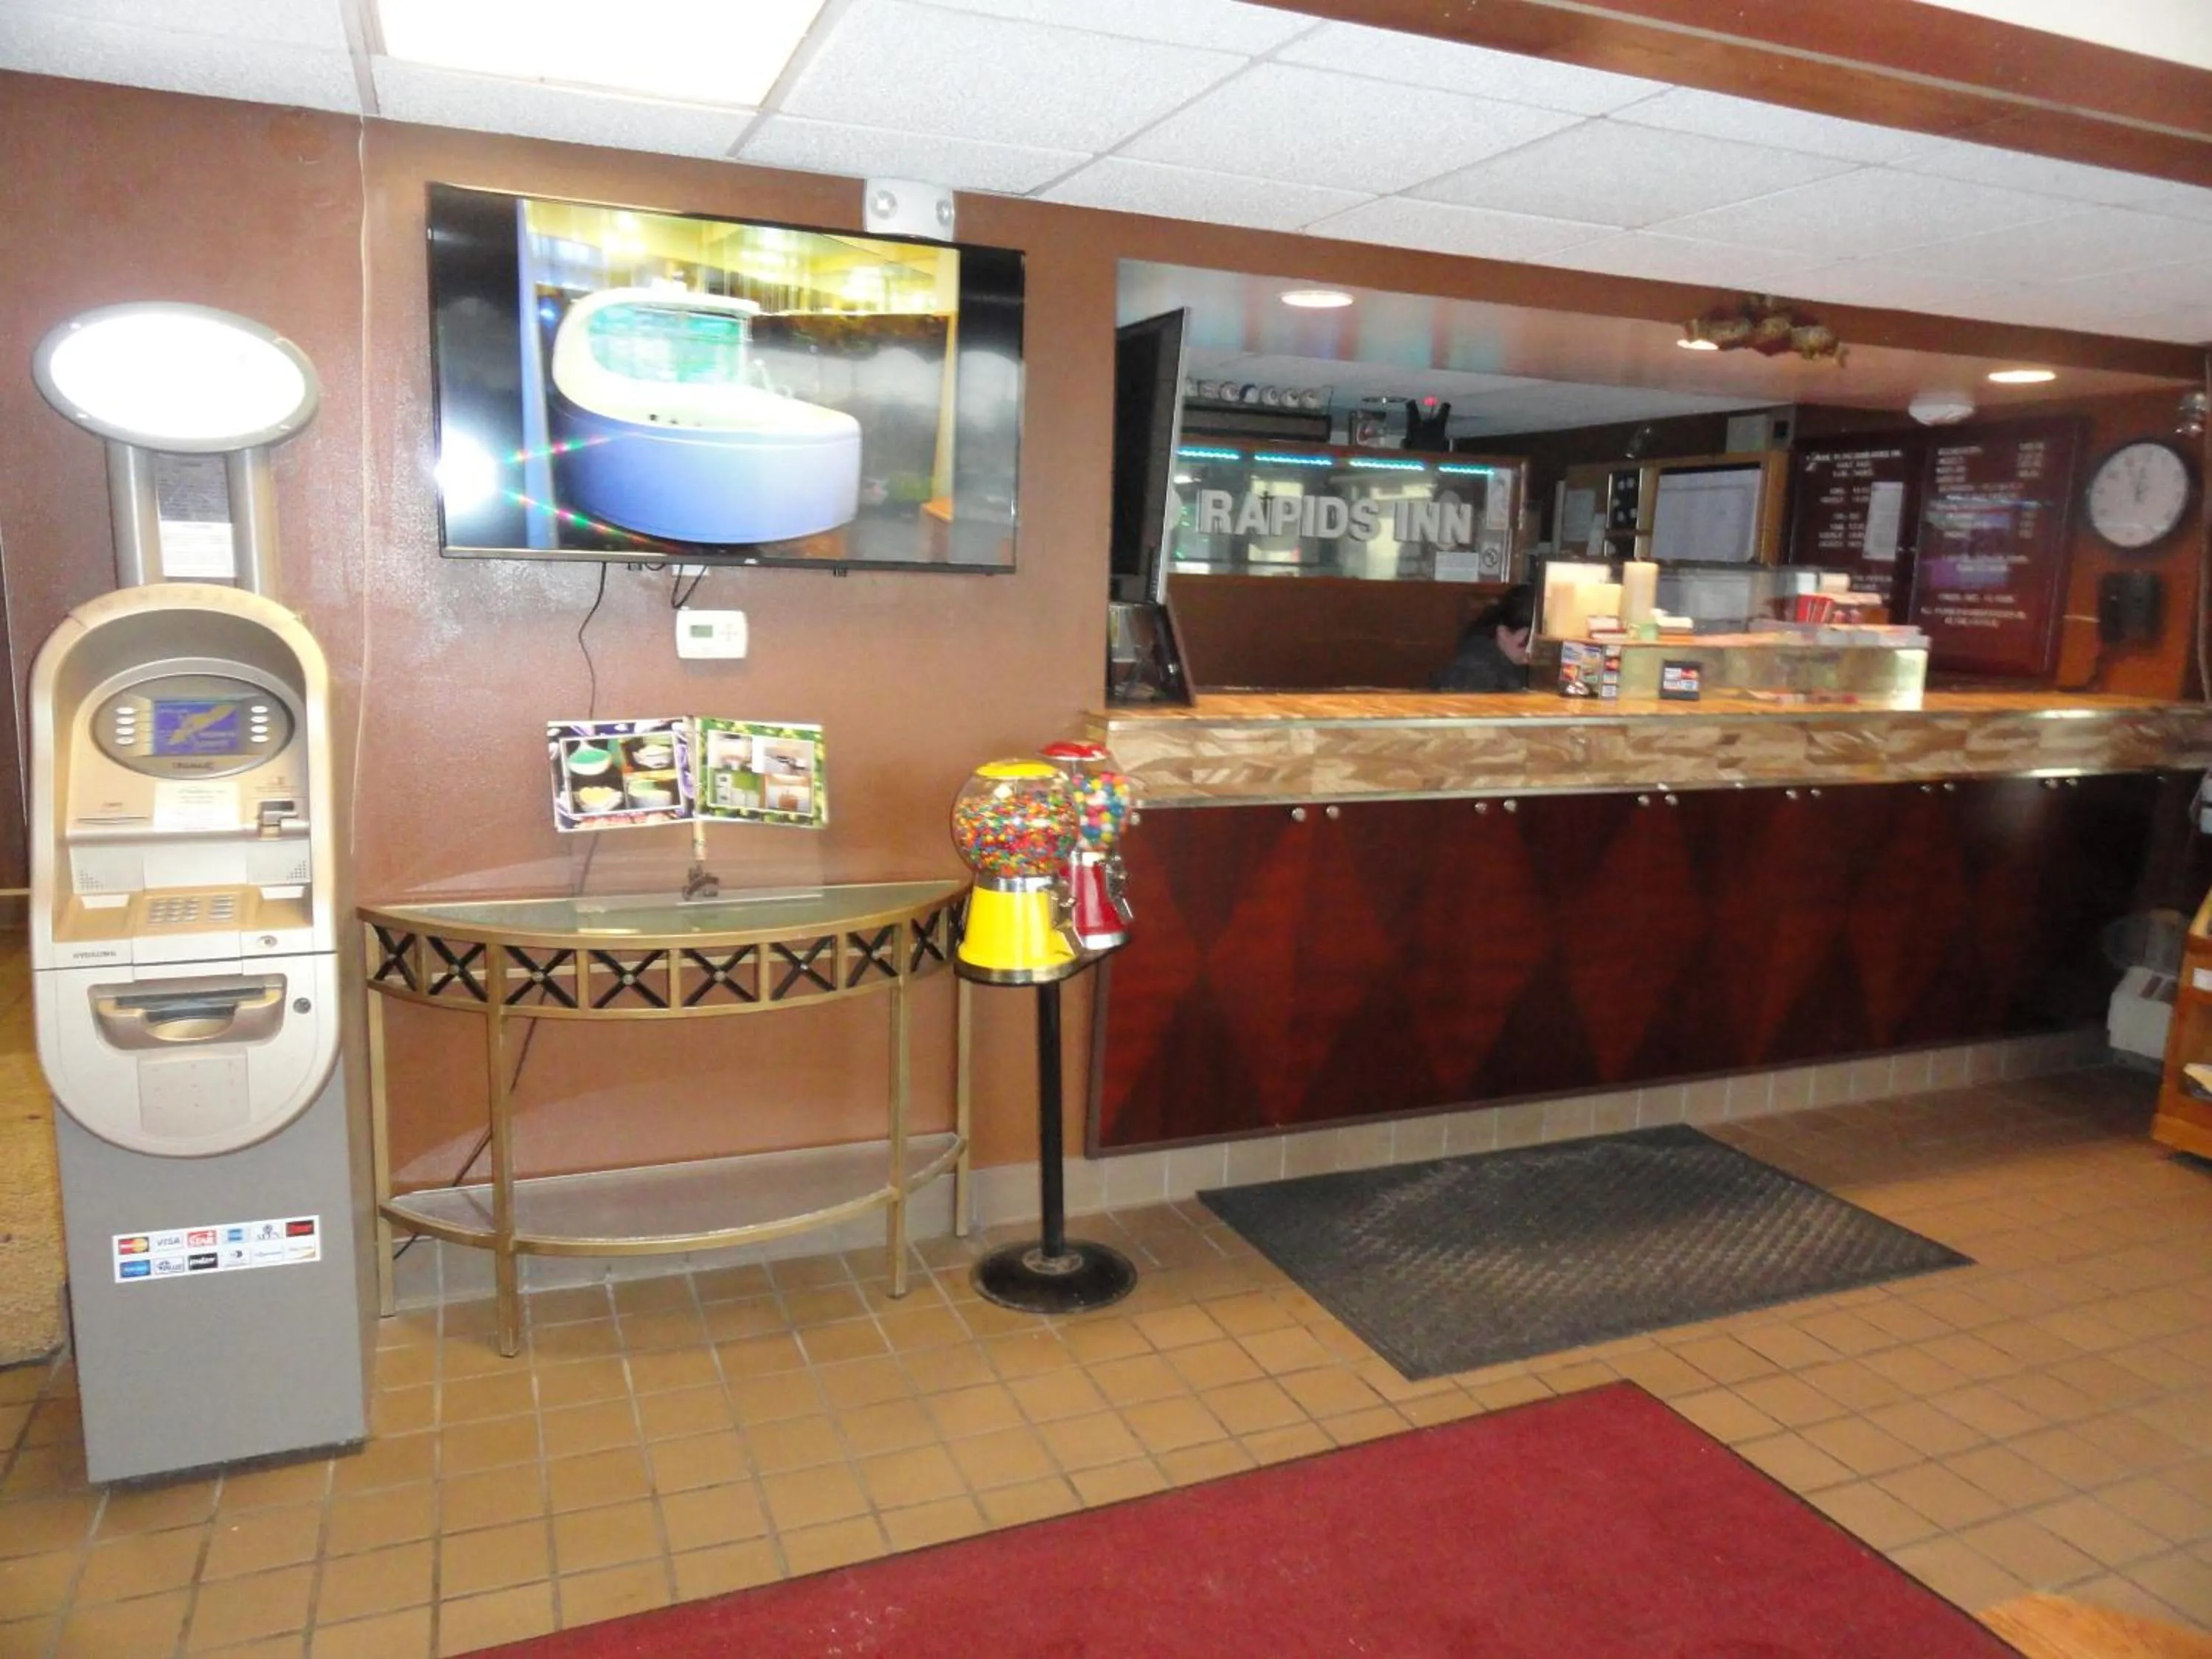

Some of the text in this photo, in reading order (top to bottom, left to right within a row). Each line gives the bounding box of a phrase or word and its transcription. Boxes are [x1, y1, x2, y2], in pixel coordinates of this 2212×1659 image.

[1198, 489, 1381, 542] RAPIDS
[1393, 501, 1472, 544] INN
[157, 1237, 181, 1247] VISA
